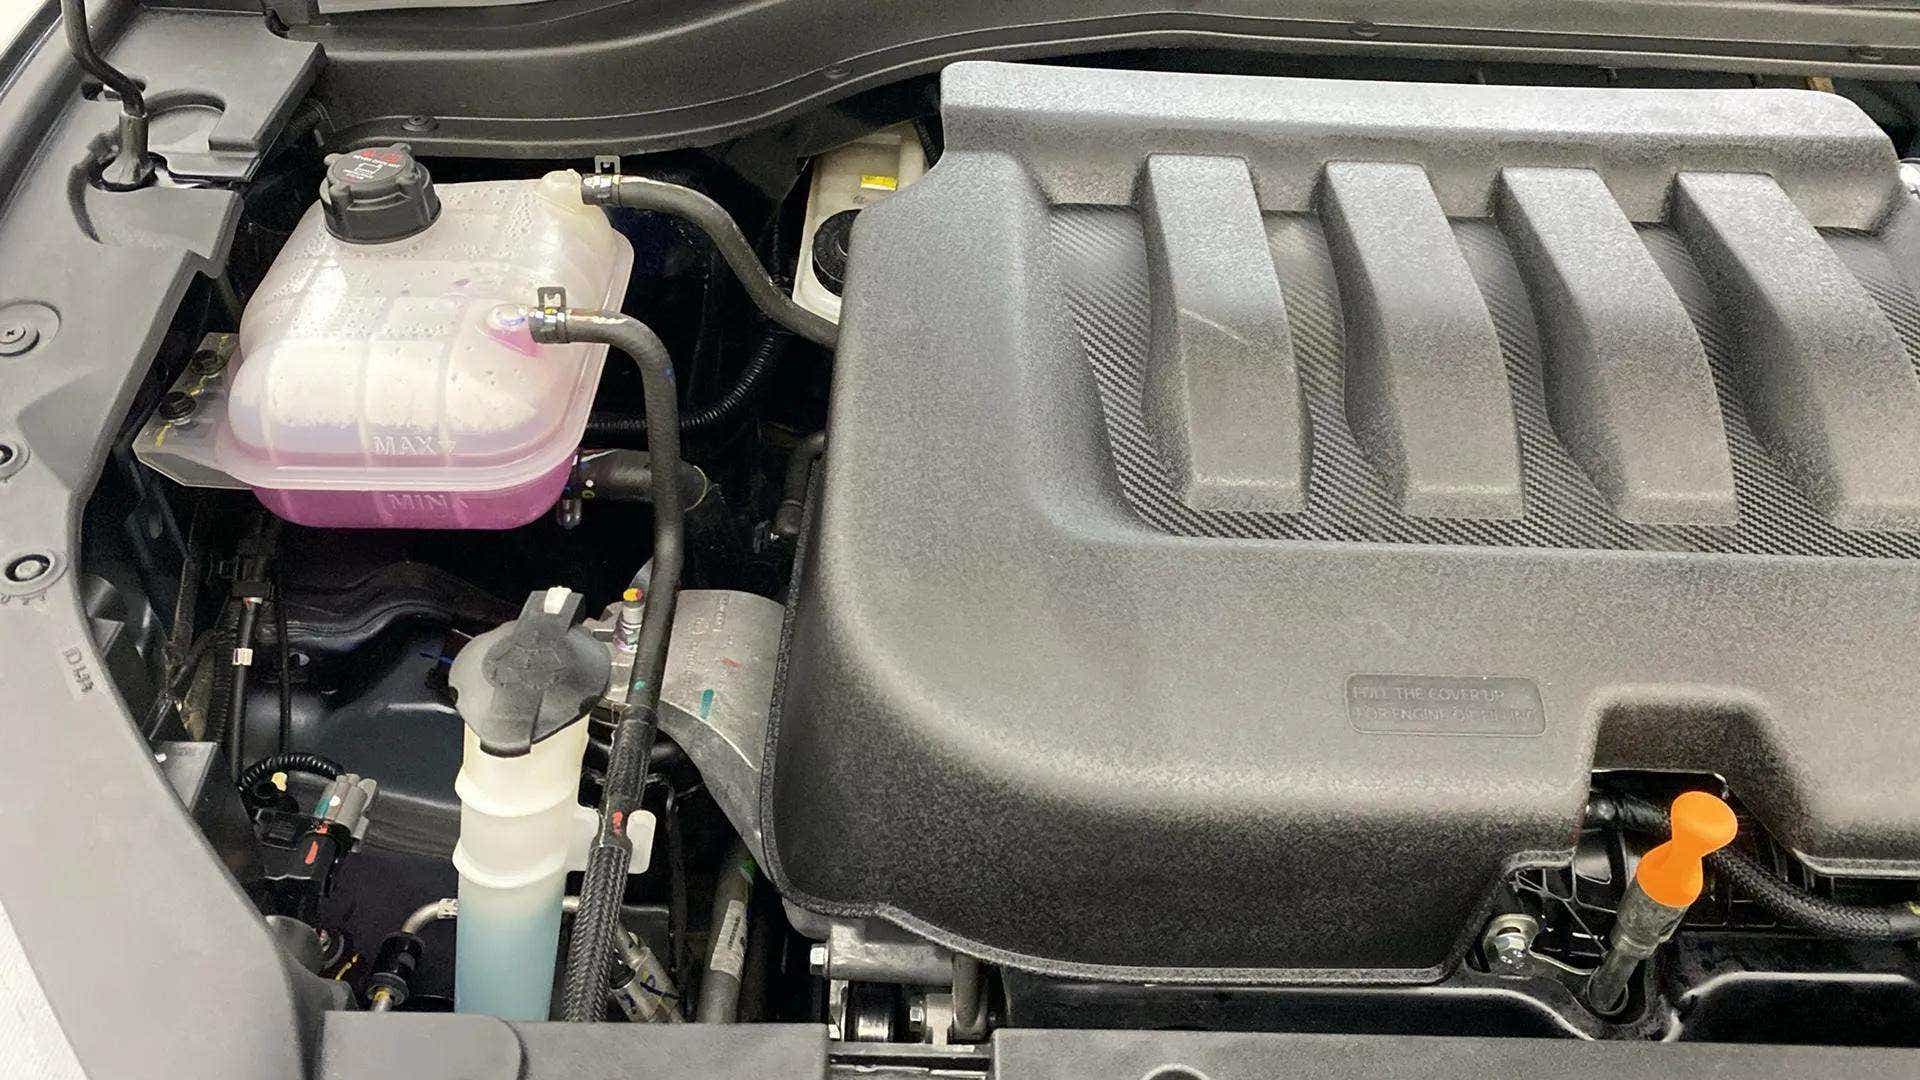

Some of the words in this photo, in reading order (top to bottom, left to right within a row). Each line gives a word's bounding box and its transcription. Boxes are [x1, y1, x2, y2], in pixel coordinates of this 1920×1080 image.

[374, 436, 436, 455] MAX
[386, 494, 448, 511] MIN
[1396, 687, 1424, 700] THE
[1428, 687, 1479, 701] COVER
